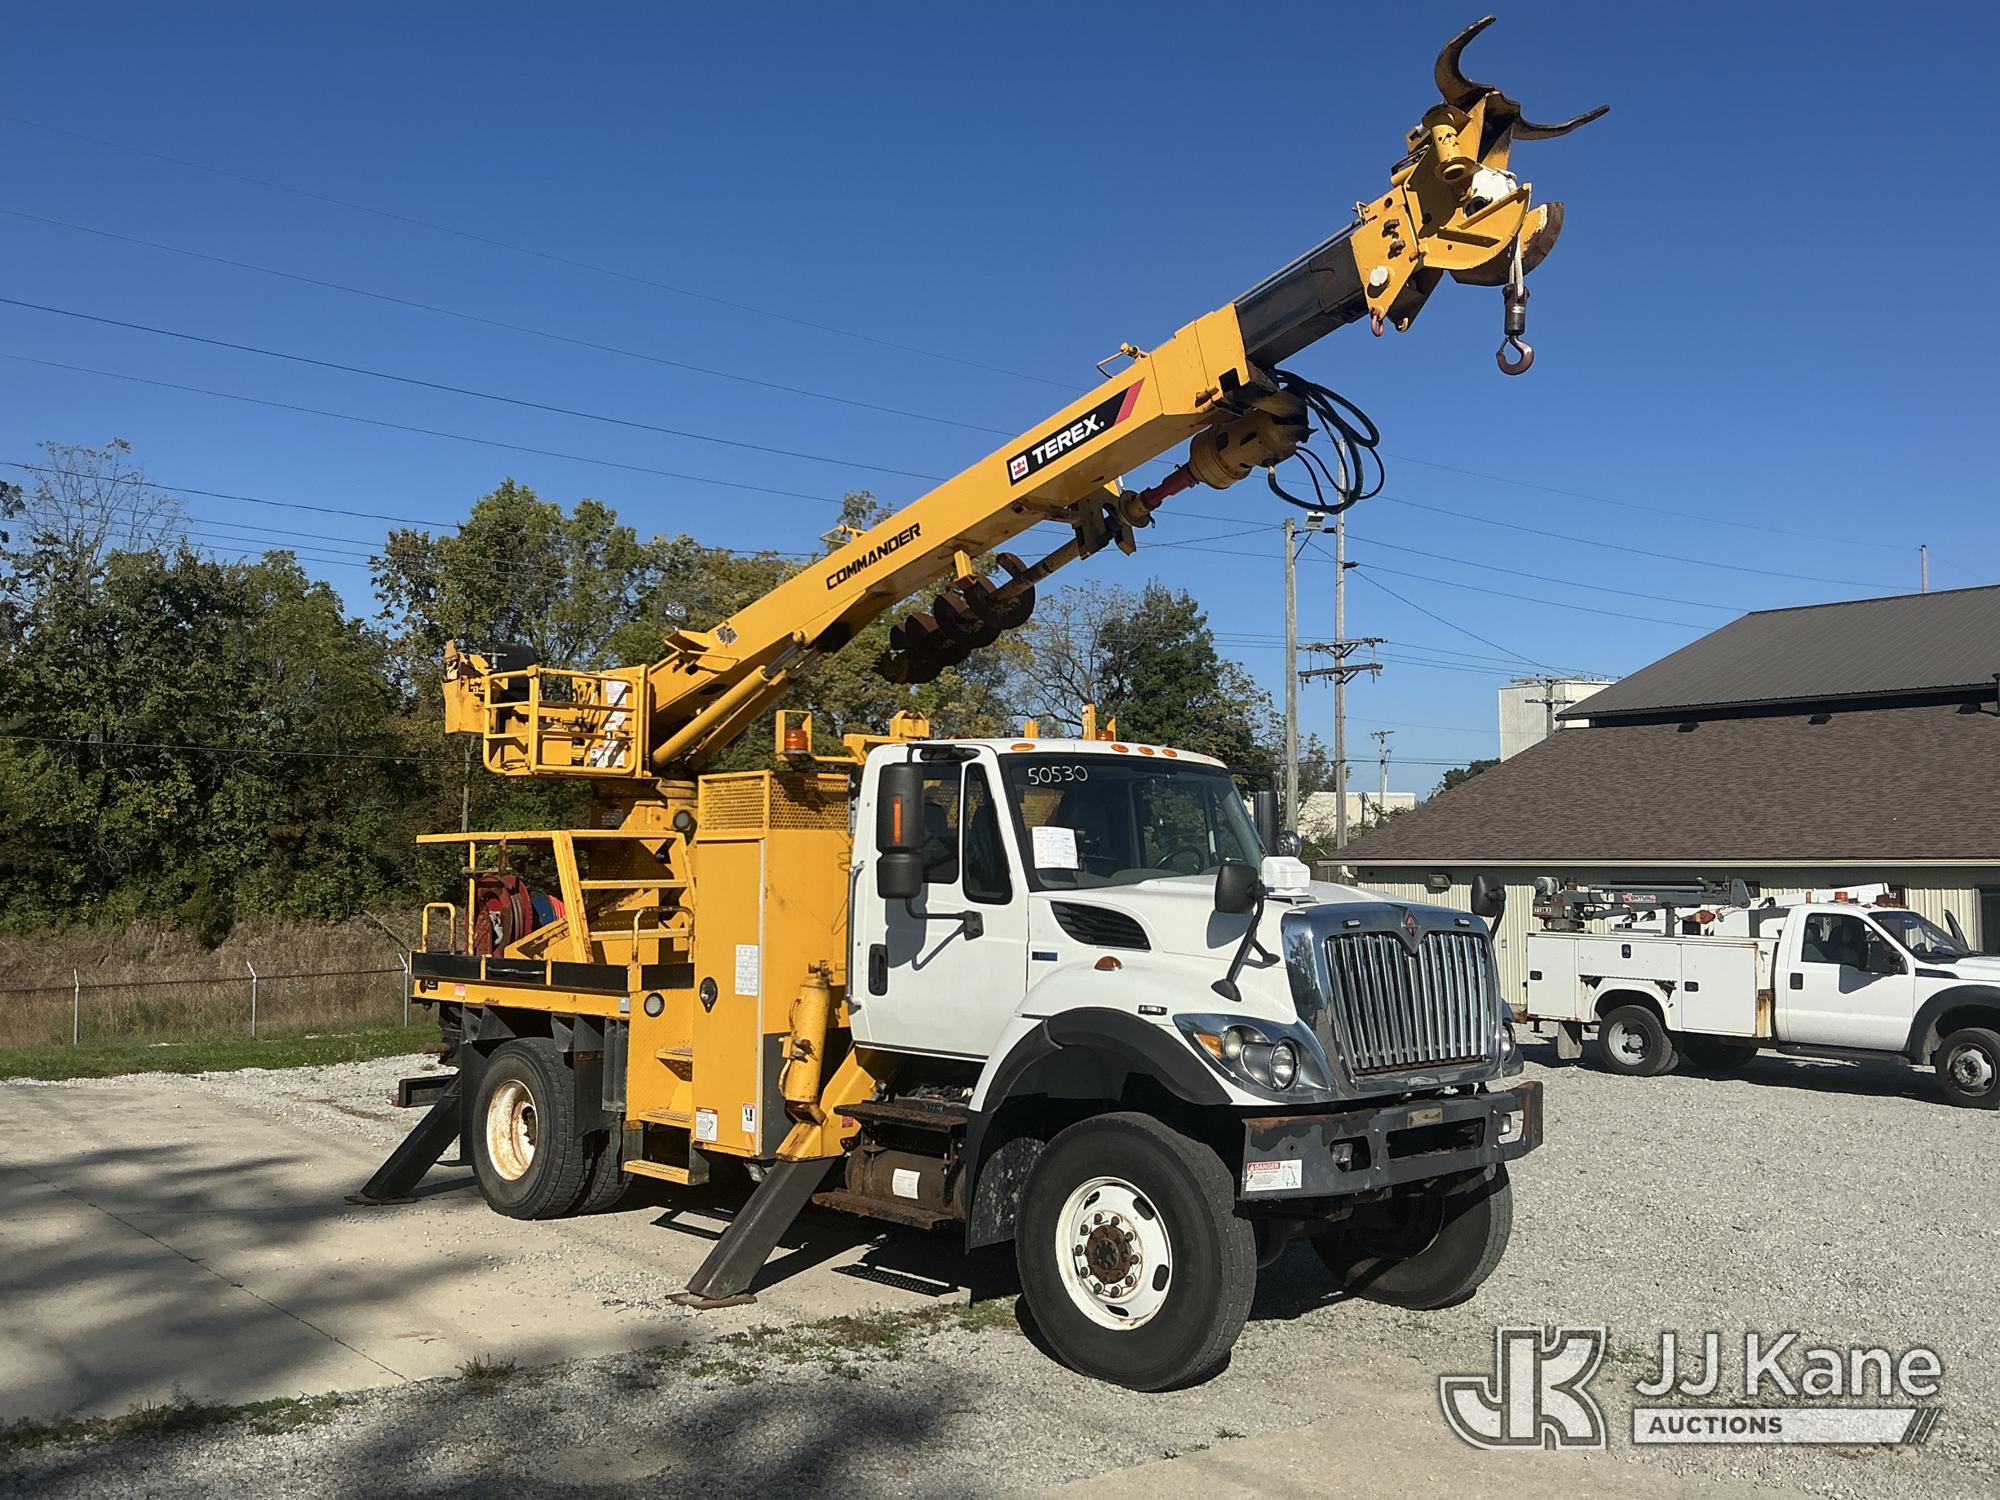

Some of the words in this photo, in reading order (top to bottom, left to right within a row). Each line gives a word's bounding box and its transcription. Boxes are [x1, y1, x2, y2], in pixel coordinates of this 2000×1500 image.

[1032, 413, 1100, 464] TEREX
[826, 522, 921, 590] COMMANDER
[1028, 765, 1088, 785] 50530
[1254, 1163, 1279, 1171] DANGER
